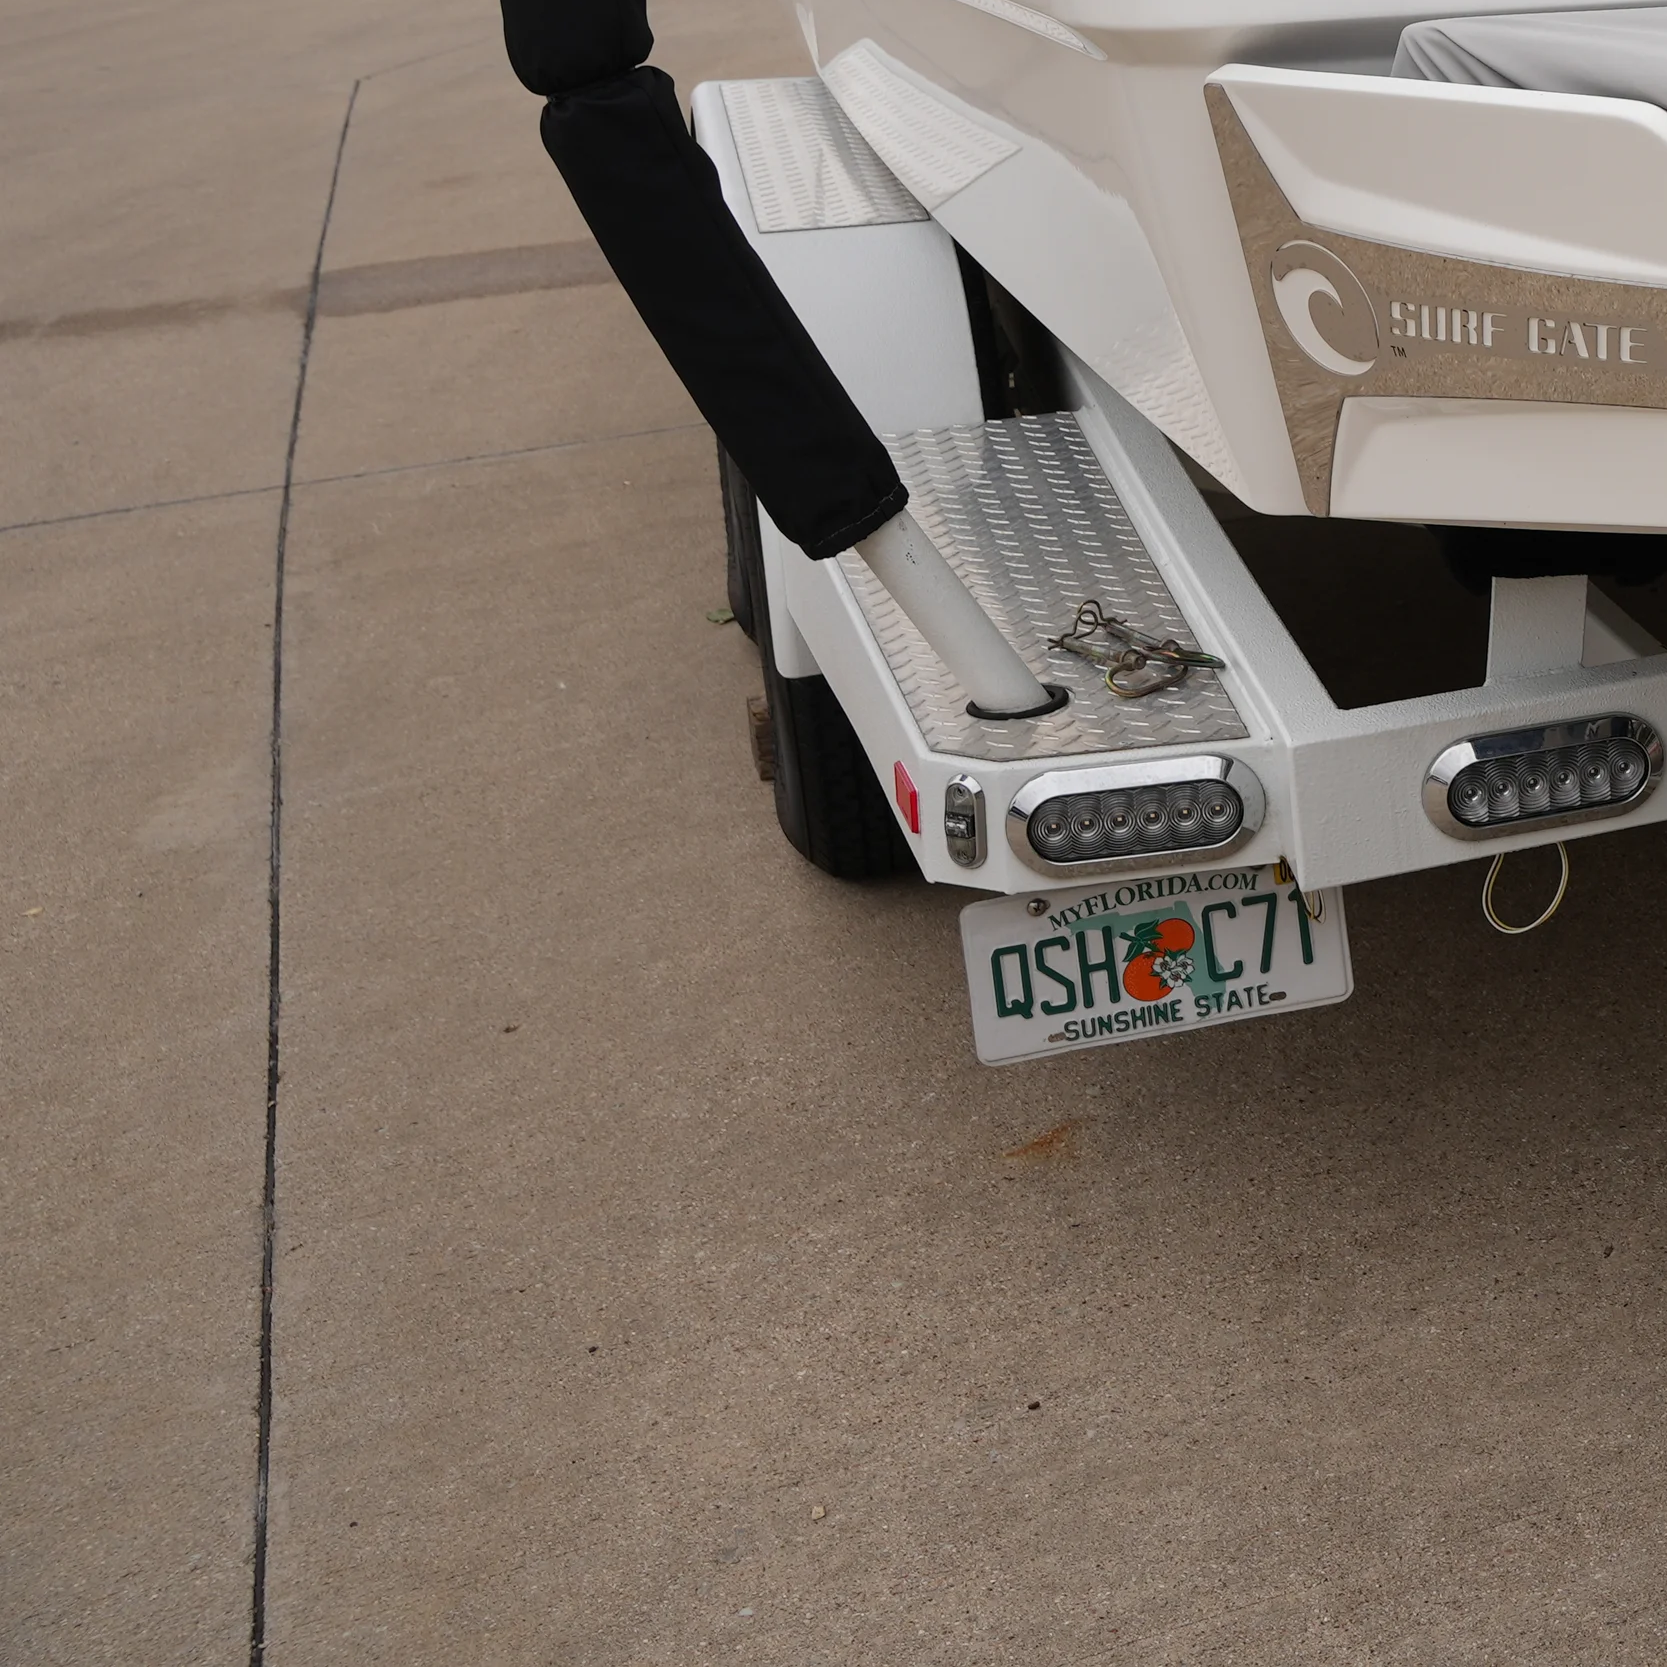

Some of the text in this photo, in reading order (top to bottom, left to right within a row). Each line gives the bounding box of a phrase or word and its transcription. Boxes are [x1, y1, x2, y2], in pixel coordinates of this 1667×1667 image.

[1390, 299, 1648, 365] SURF GATE
[1390, 345, 1408, 359] TM
[1048, 872, 1259, 931] MYFLORIDA.COM
[991, 888, 1313, 1020] QSH C71
[1065, 983, 1270, 1042] SUNSHINE STATE
